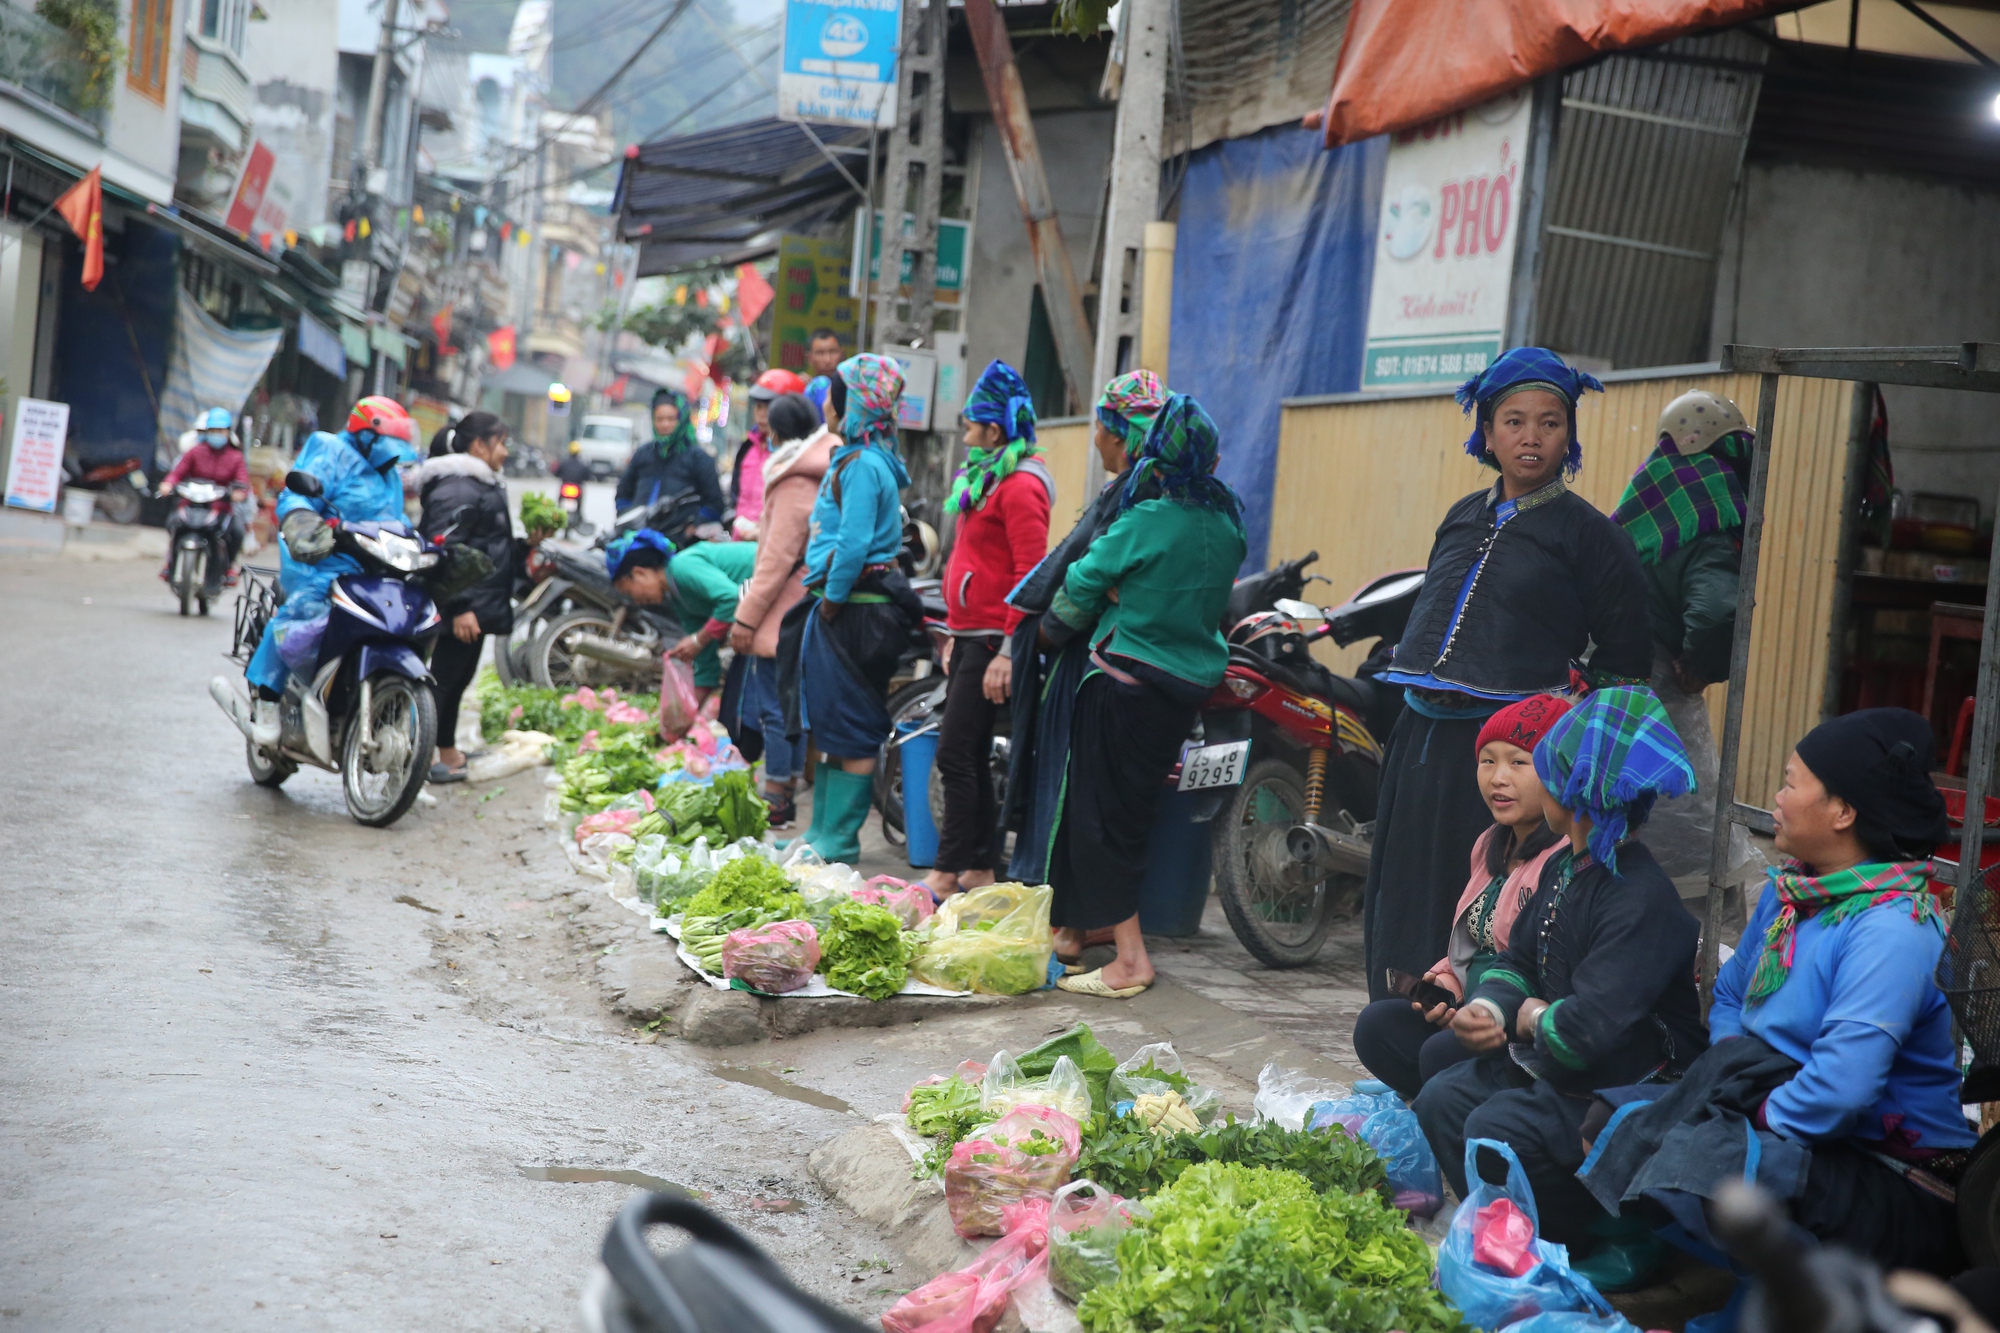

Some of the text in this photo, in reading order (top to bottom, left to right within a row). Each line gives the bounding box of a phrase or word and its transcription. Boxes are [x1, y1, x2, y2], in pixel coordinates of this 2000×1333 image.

[1433, 137, 1517, 259] PHỞ
[1509, 722, 1537, 746] M
[1186, 764, 1235, 788] 9295
